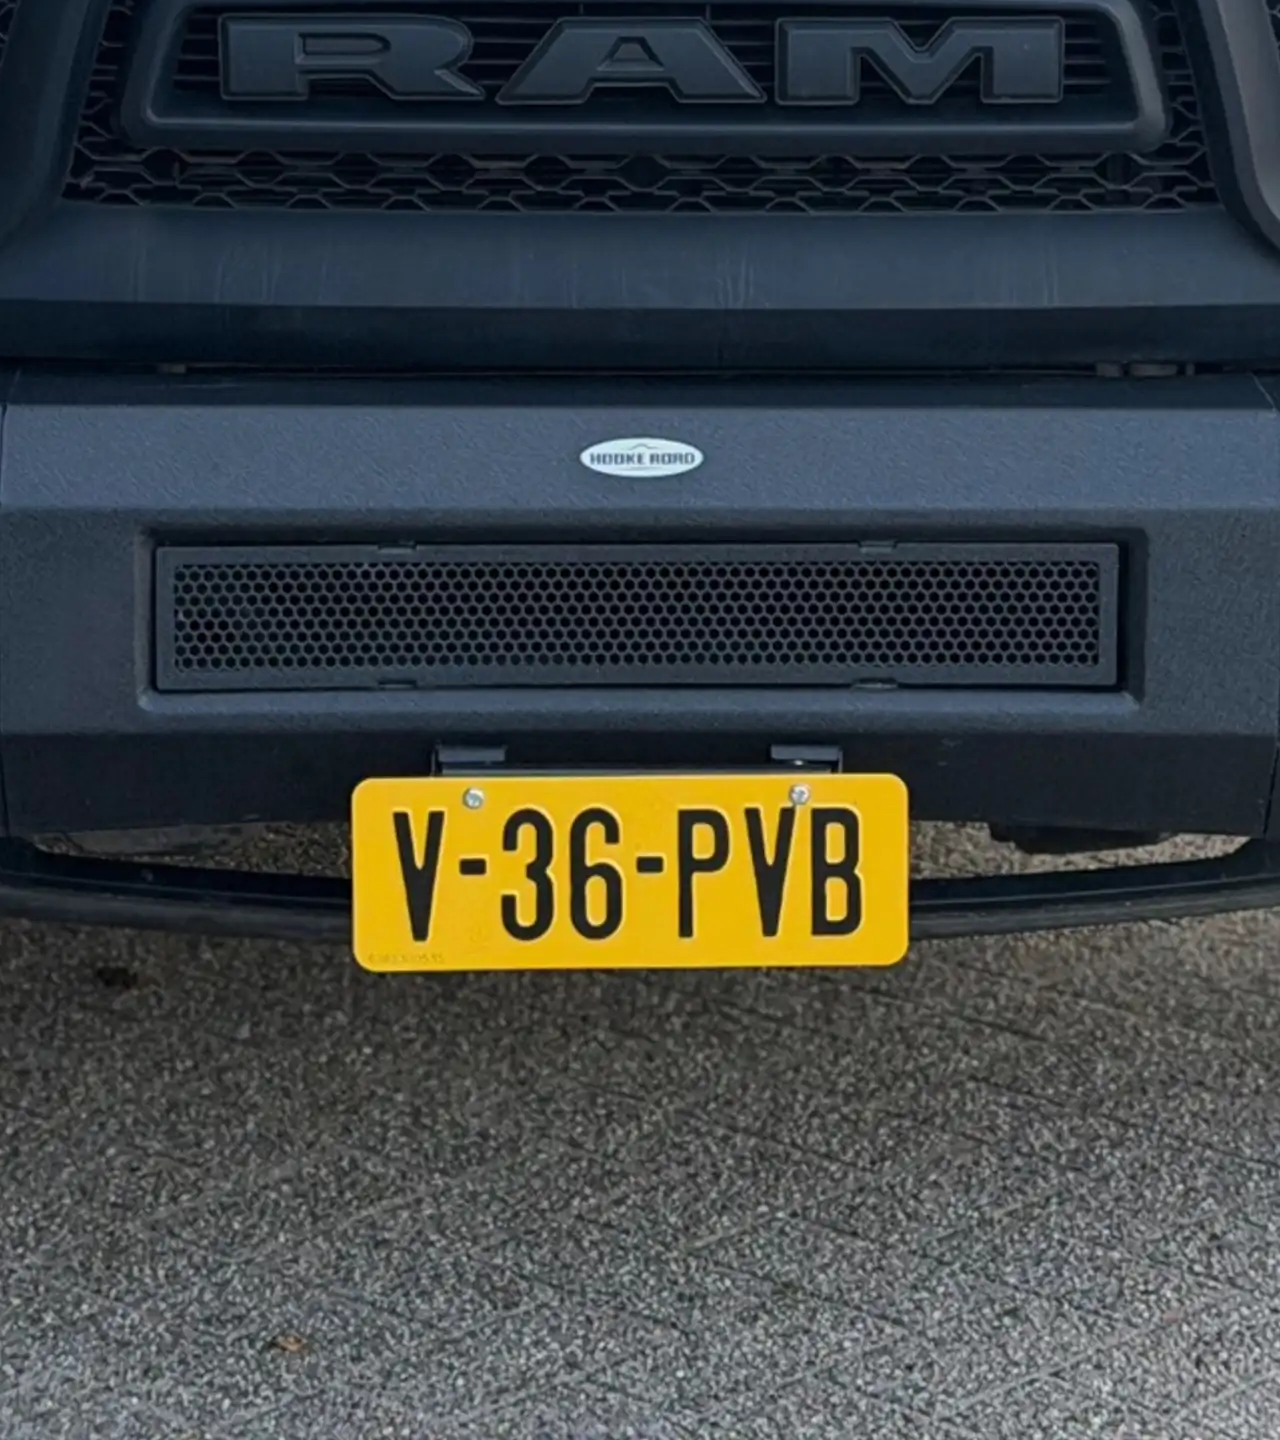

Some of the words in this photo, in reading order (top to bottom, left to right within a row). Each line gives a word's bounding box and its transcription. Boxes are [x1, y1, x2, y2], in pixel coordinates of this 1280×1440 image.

[219, 12, 1066, 106] RAM
[589, 452, 646, 465] HOOKE
[648, 452, 696, 465] ROAD
[393, 807, 862, 943] V-36-PVB
